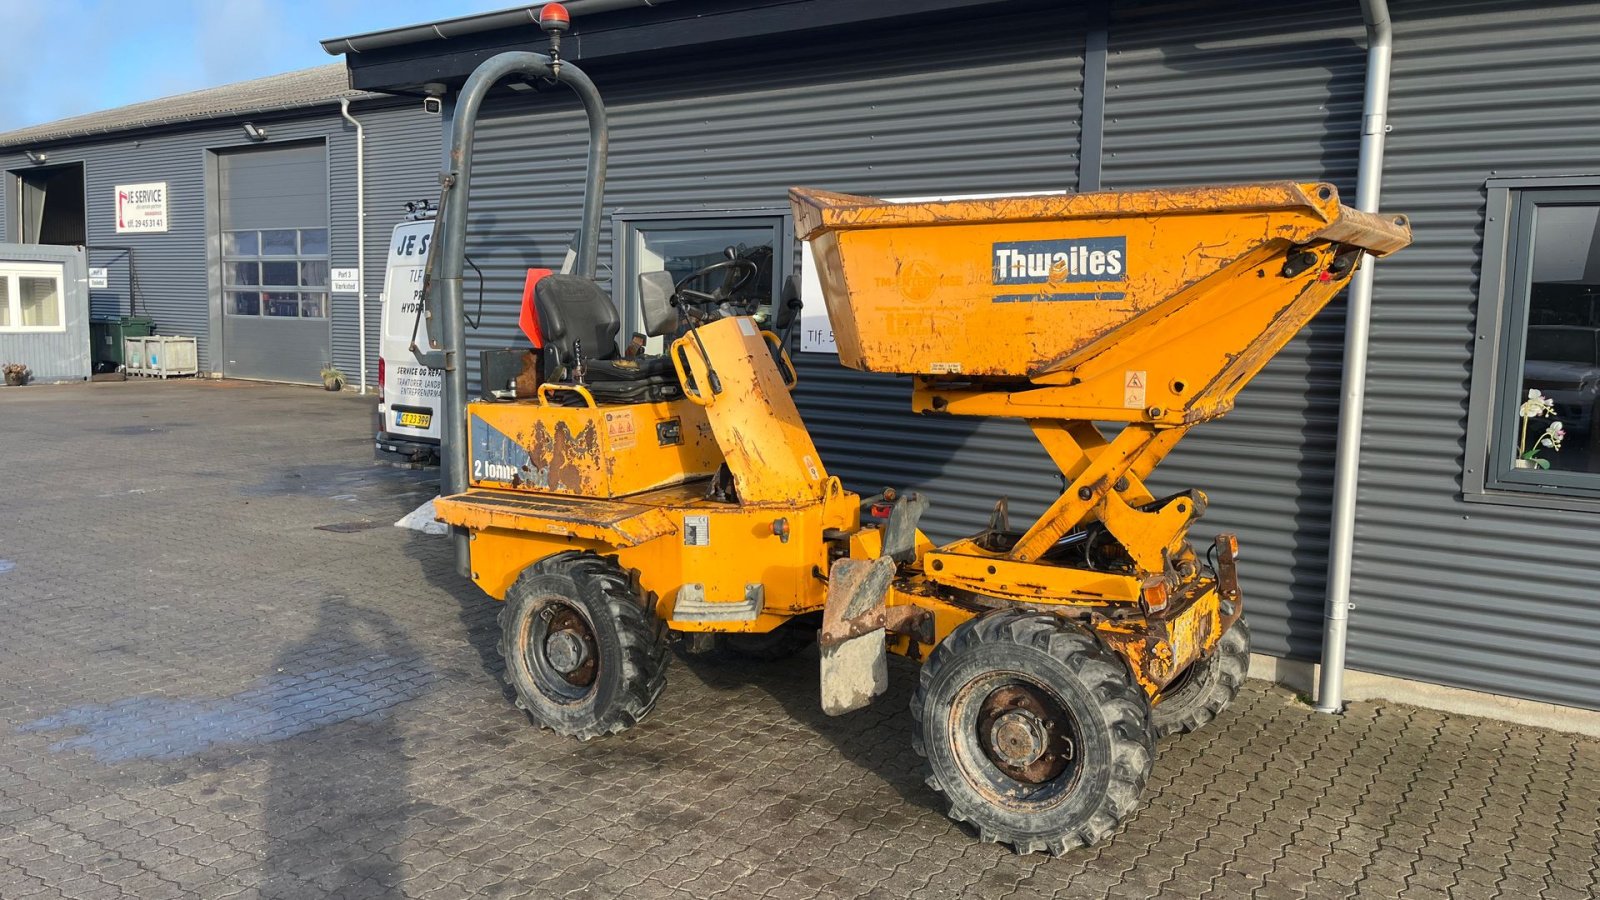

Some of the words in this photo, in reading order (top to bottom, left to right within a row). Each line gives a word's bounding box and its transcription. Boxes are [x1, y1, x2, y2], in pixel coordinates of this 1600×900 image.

[127, 190, 134, 203] JE
[135, 189, 161, 203] SERVICE
[135, 219, 141, 227] 29
[142, 219, 149, 227] 45
[149, 219, 155, 227] 31
[156, 218, 162, 227] 41
[396, 234, 416, 256] JE
[418, 233, 431, 255] S
[996, 246, 1122, 278] Thwaites
[807, 329, 825, 345] Tlf.
[397, 366, 418, 376] SERVICE
[418, 368, 427, 376] OG
[409, 414, 417, 424] 23
[474, 460, 482, 477] 2
[484, 460, 518, 480] tonne
